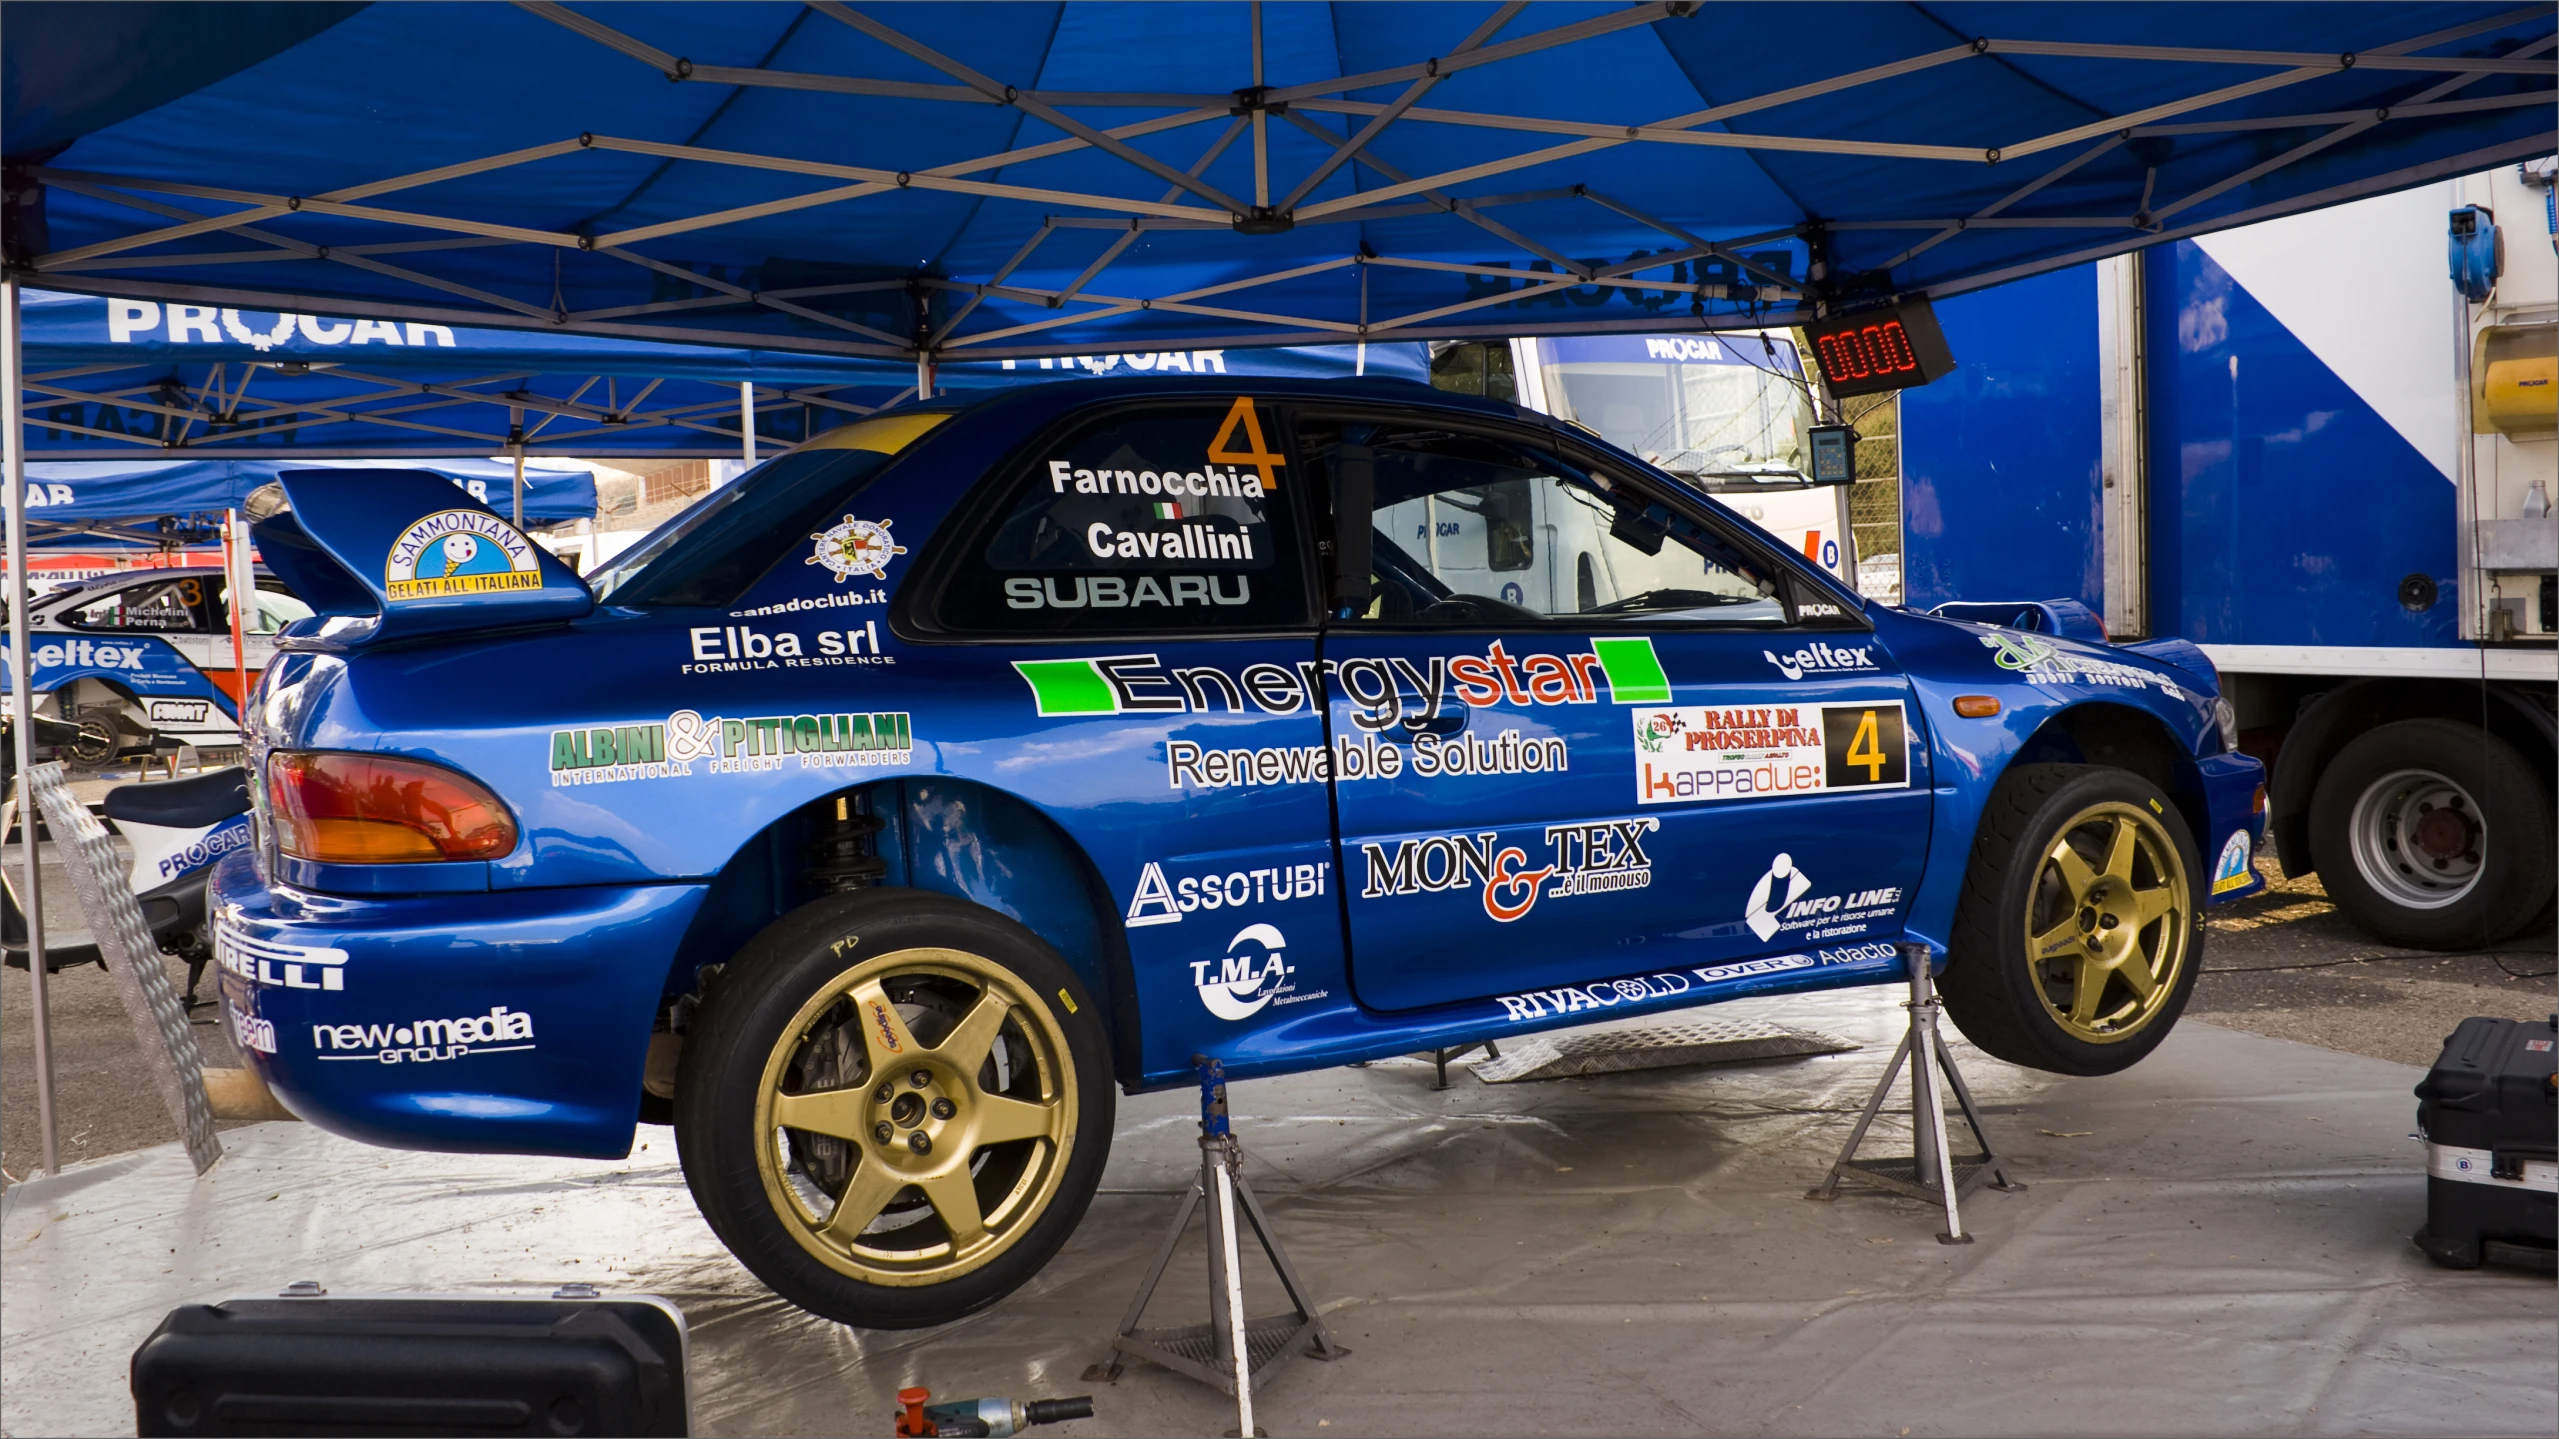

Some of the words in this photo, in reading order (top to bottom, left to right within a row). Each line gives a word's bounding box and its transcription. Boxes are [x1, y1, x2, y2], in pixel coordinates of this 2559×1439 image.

[1645, 338, 1723, 361] PROCAR
[1207, 396, 1286, 490] 4
[1048, 460, 1265, 498] Farnocchia
[392, 512, 527, 567] SAMMONTANA
[826, 522, 859, 538] NAVALE
[1087, 522, 1254, 560] Cavallini
[842, 563, 877, 573] ITALIA
[179, 578, 203, 607] 3
[388, 580, 438, 599] GELATI
[1004, 575, 1251, 610] SUBARU
[126, 606, 189, 618] Michelini
[729, 588, 888, 618] canadoclub.it
[126, 617, 167, 627] Perna
[689, 625, 804, 661] Elba
[817, 620, 881, 656] srl
[681, 659, 780, 675] FORMULA
[785, 656, 897, 668] RESIDENCE
[1094, 638, 1600, 730] Energystar
[1652, 720, 1667, 732] 26
[1704, 708, 1771, 731] RALLY
[1776, 707, 1800, 728] DI
[551, 723, 667, 772] ALBINI
[667, 709, 721, 763] &
[720, 712, 912, 758] PITIGLIANI
[1684, 727, 1822, 751] PROSERPINA
[1846, 710, 1886, 782] 4
[553, 763, 692, 786] INTERNATIONAL
[710, 757, 784, 774] FREIGHT
[801, 751, 911, 768] FORWARDERS
[1167, 734, 1402, 789] Renewable
[1411, 727, 1569, 776] Solution
[158, 823, 252, 878] PROCAR
[1574, 872, 1588, 893] il
[1587, 868, 1651, 892] monouso
[1786, 895, 1842, 919] INFO
[1844, 887, 1897, 909] LINE
[1780, 918, 1817, 932] Software
[1816, 916, 1832, 928] per
[1831, 914, 1840, 923] le
[1840, 910, 1867, 922] risorse
[1867, 907, 1896, 918] umane
[1805, 931, 1812, 940] e
[1813, 929, 1820, 939] la
[1821, 923, 1867, 938] ristorazione
[830, 935, 860, 958] PD
[1818, 941, 1898, 967] Adacto
[1189, 952, 1296, 987] T.M.A.
[1703, 958, 1790, 978] OVER
[1257, 981, 1297, 997] Lavorazioni
[1272, 988, 1329, 1007] Metalmeccaniche
[1495, 973, 1690, 1021] RIVACOLD
[378, 1043, 469, 1065] GROUP
